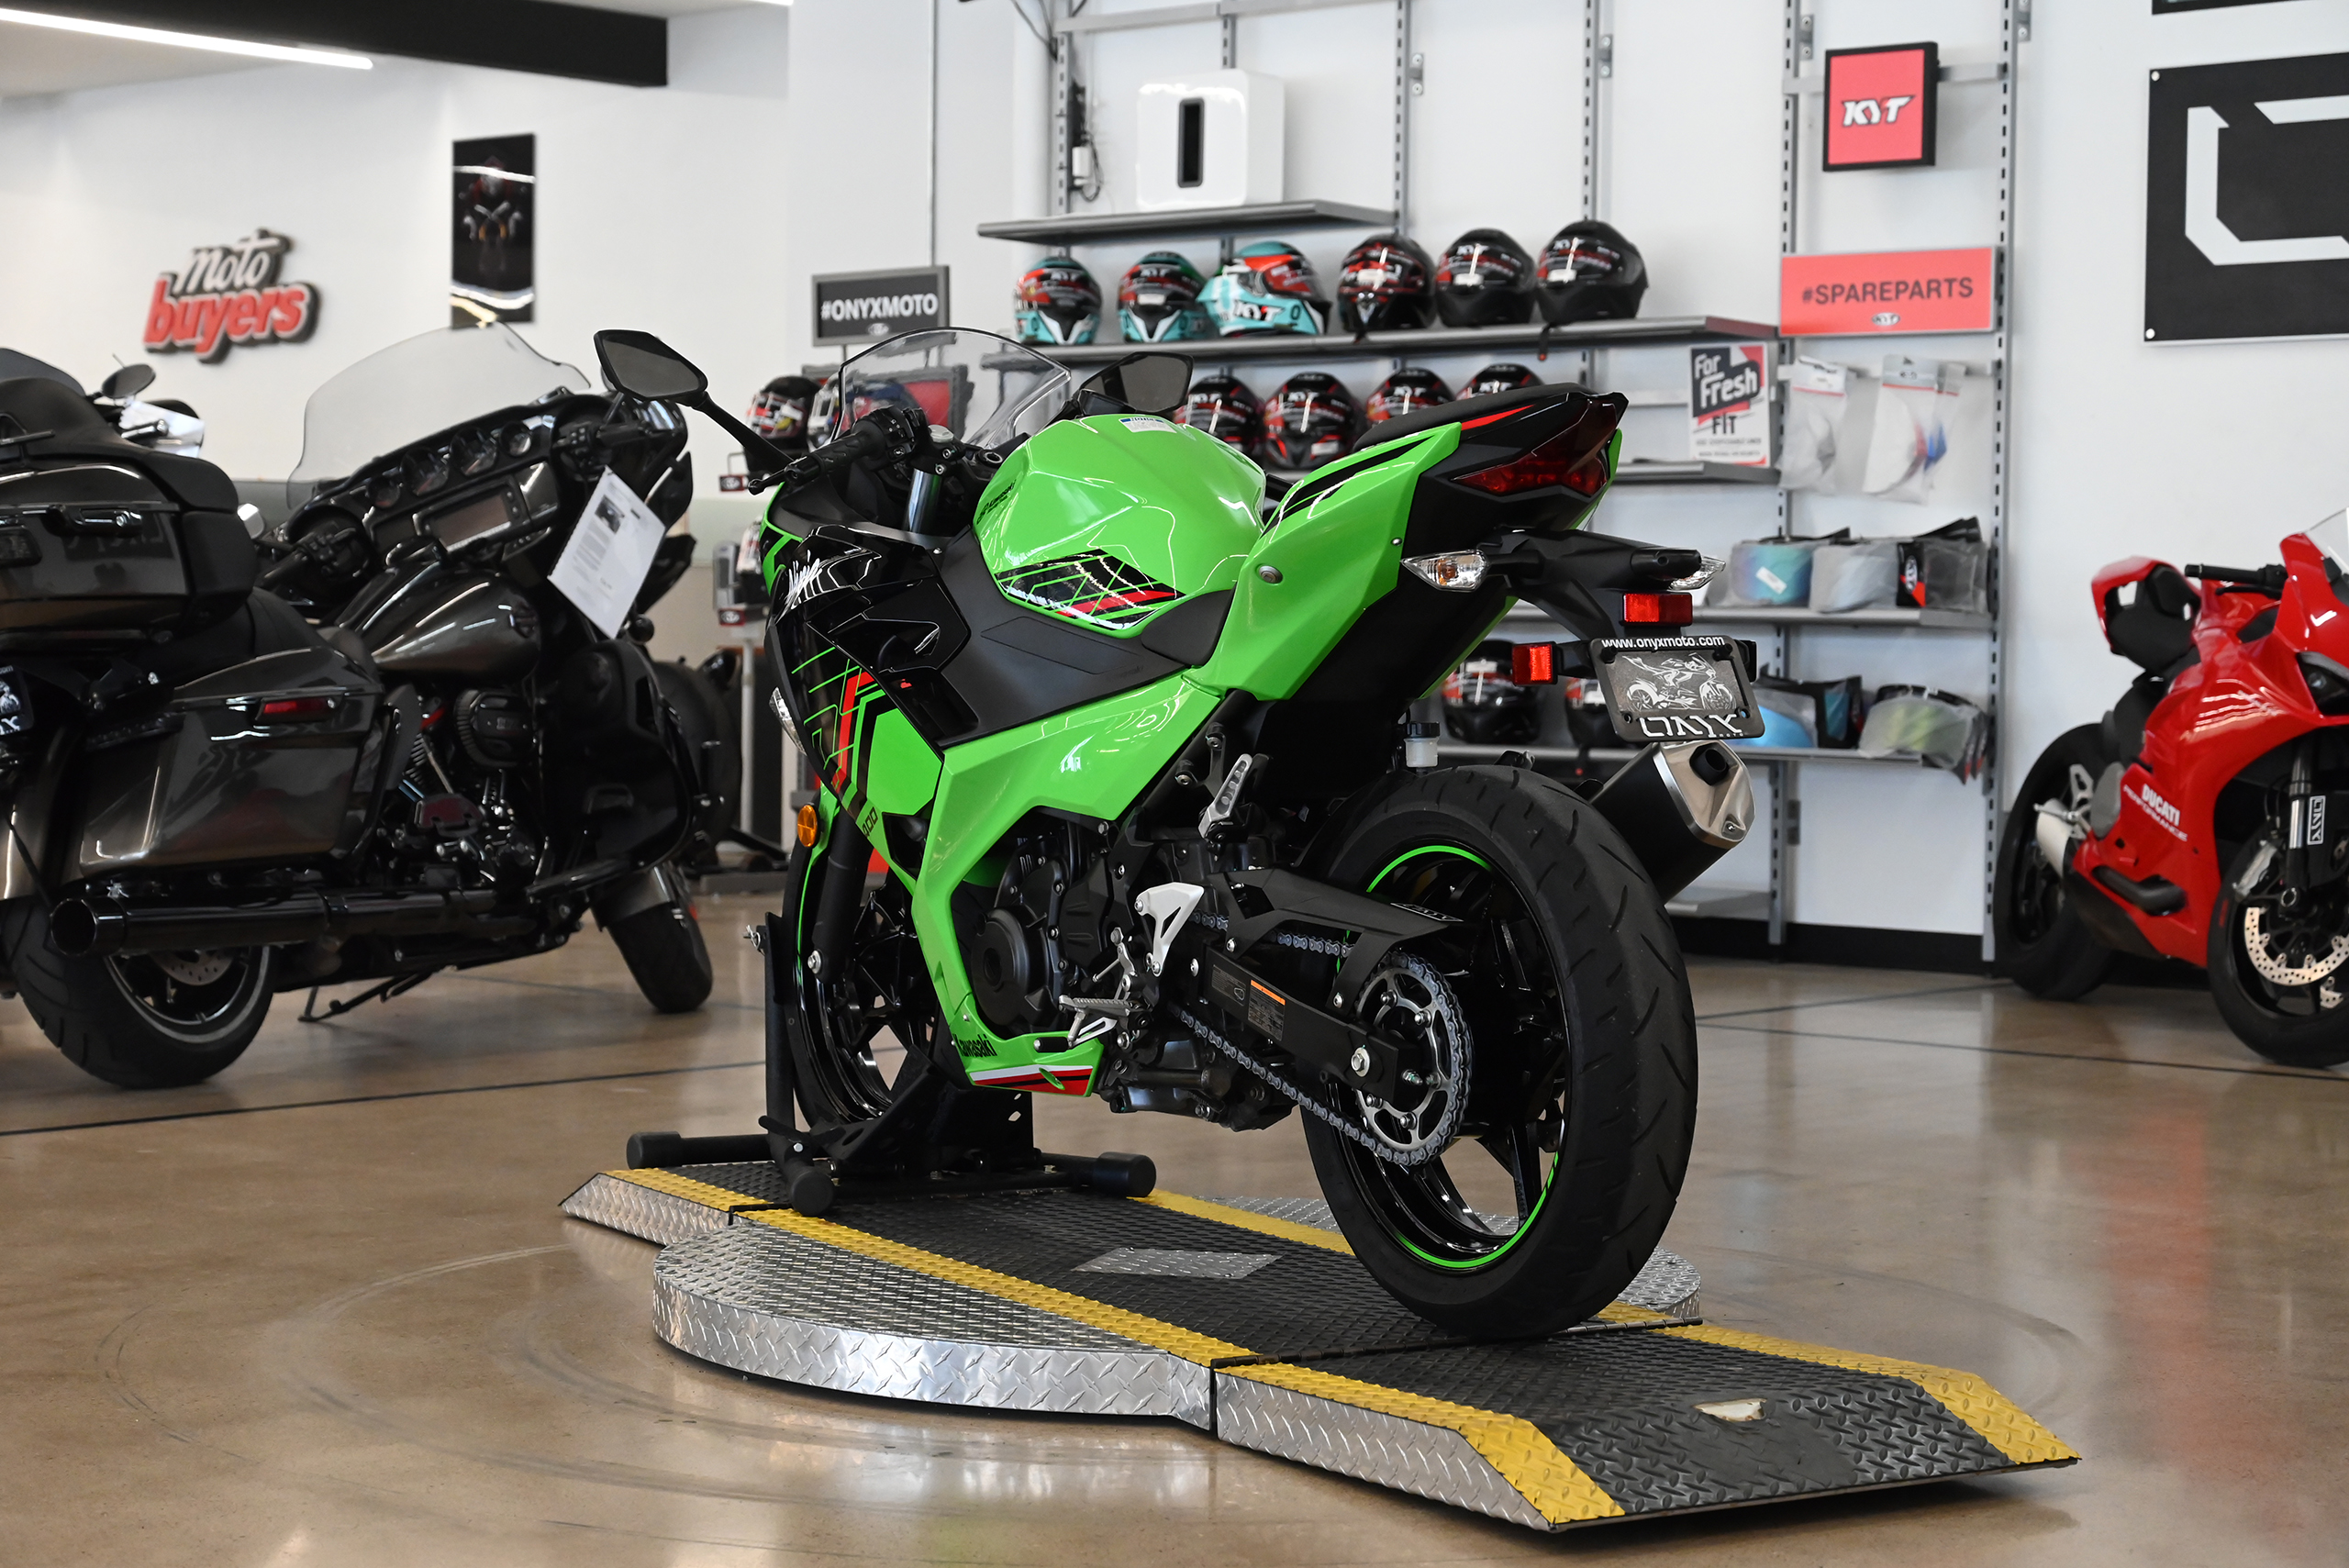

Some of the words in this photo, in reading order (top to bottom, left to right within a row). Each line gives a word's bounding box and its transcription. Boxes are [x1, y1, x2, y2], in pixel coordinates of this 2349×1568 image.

[1841, 95, 1915, 127] KYT
[1802, 276, 1973, 305] #SPAREPARTS
[142, 276, 307, 355] buyers
[820, 293, 939, 322] #ONYXMOTO
[1694, 353, 1721, 380] For
[1700, 368, 1758, 409] Fresh
[1712, 412, 1737, 434] FIT
[1601, 636, 1725, 651] www.onyxmoto.com
[1640, 714, 1742, 738] ONYX
[2142, 783, 2181, 827] DUCATI
[952, 1033, 998, 1058] Kawasaki
